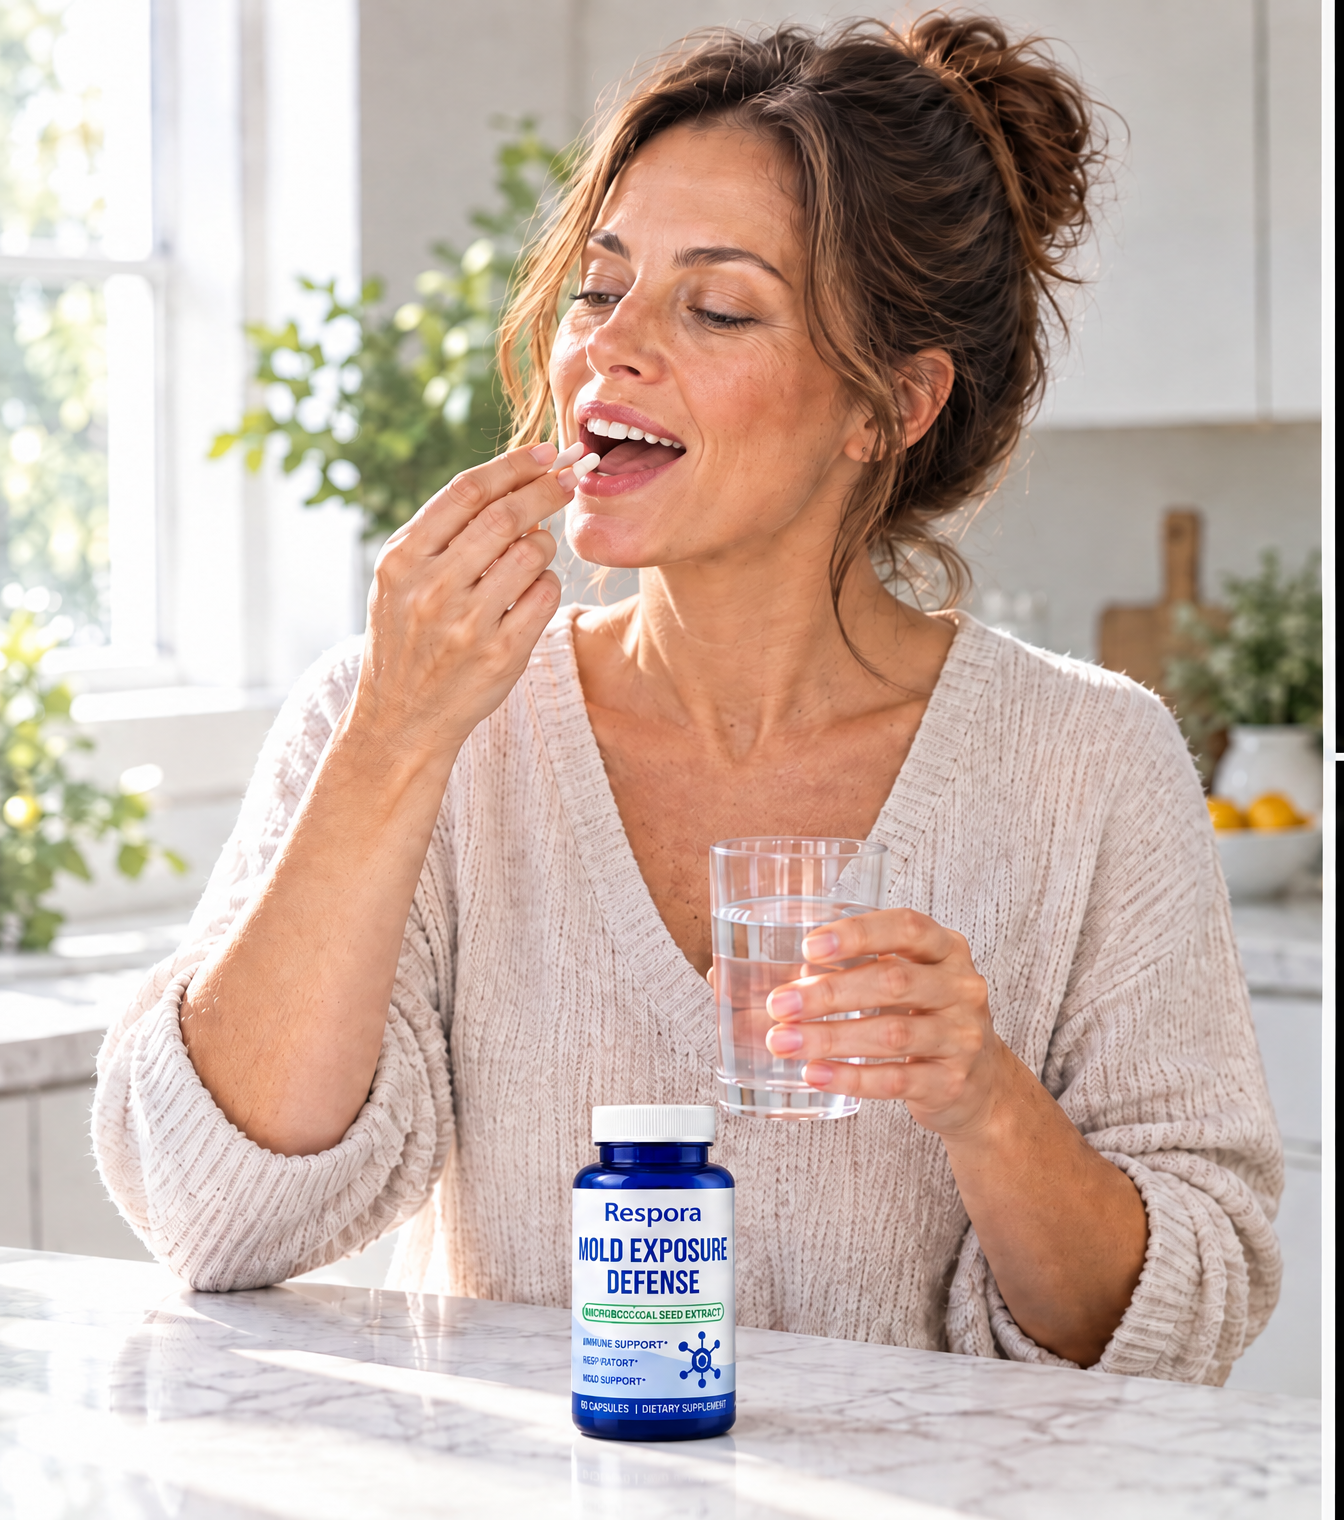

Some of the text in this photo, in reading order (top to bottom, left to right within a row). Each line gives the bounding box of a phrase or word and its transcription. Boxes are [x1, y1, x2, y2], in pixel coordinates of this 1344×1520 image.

[604, 1202, 702, 1228] Respora
[578, 1236, 728, 1263] MOLD EXPOSURE
[607, 1269, 700, 1295] DEFENSE
[659, 1309, 683, 1320] SEED
[685, 1307, 721, 1320] EXTRACT
[588, 1401, 630, 1414] CAPSULES
[642, 1403, 680, 1415] DIETARY
